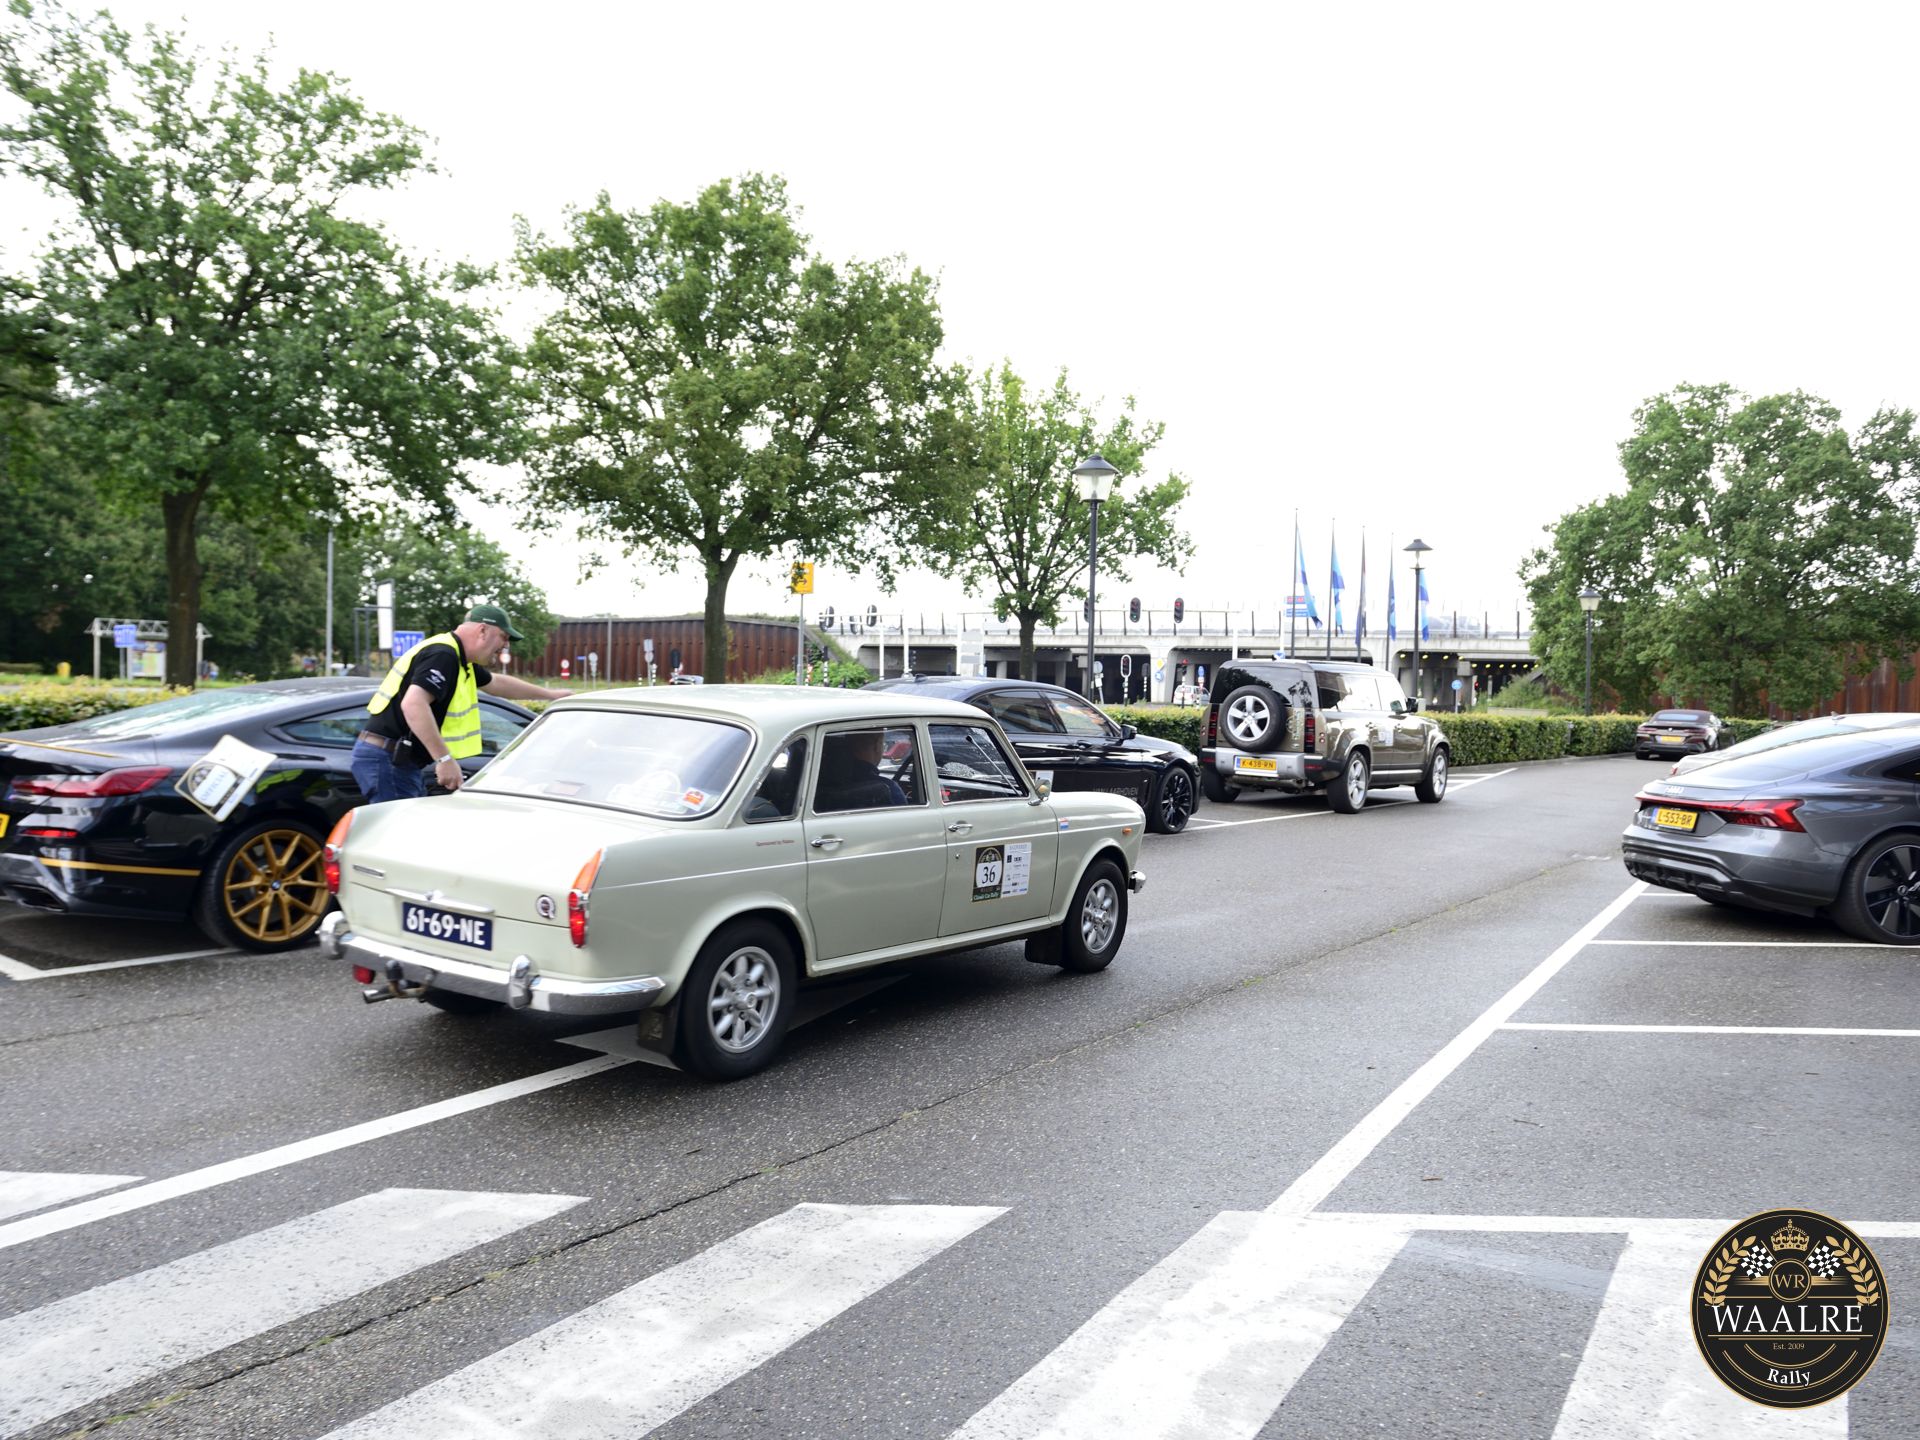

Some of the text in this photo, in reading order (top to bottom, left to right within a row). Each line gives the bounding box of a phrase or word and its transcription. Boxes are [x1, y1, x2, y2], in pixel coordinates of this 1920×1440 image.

[1658, 811, 1693, 826] L-553-BR
[982, 865, 996, 884] 36
[406, 907, 486, 946] 61-69-NE
